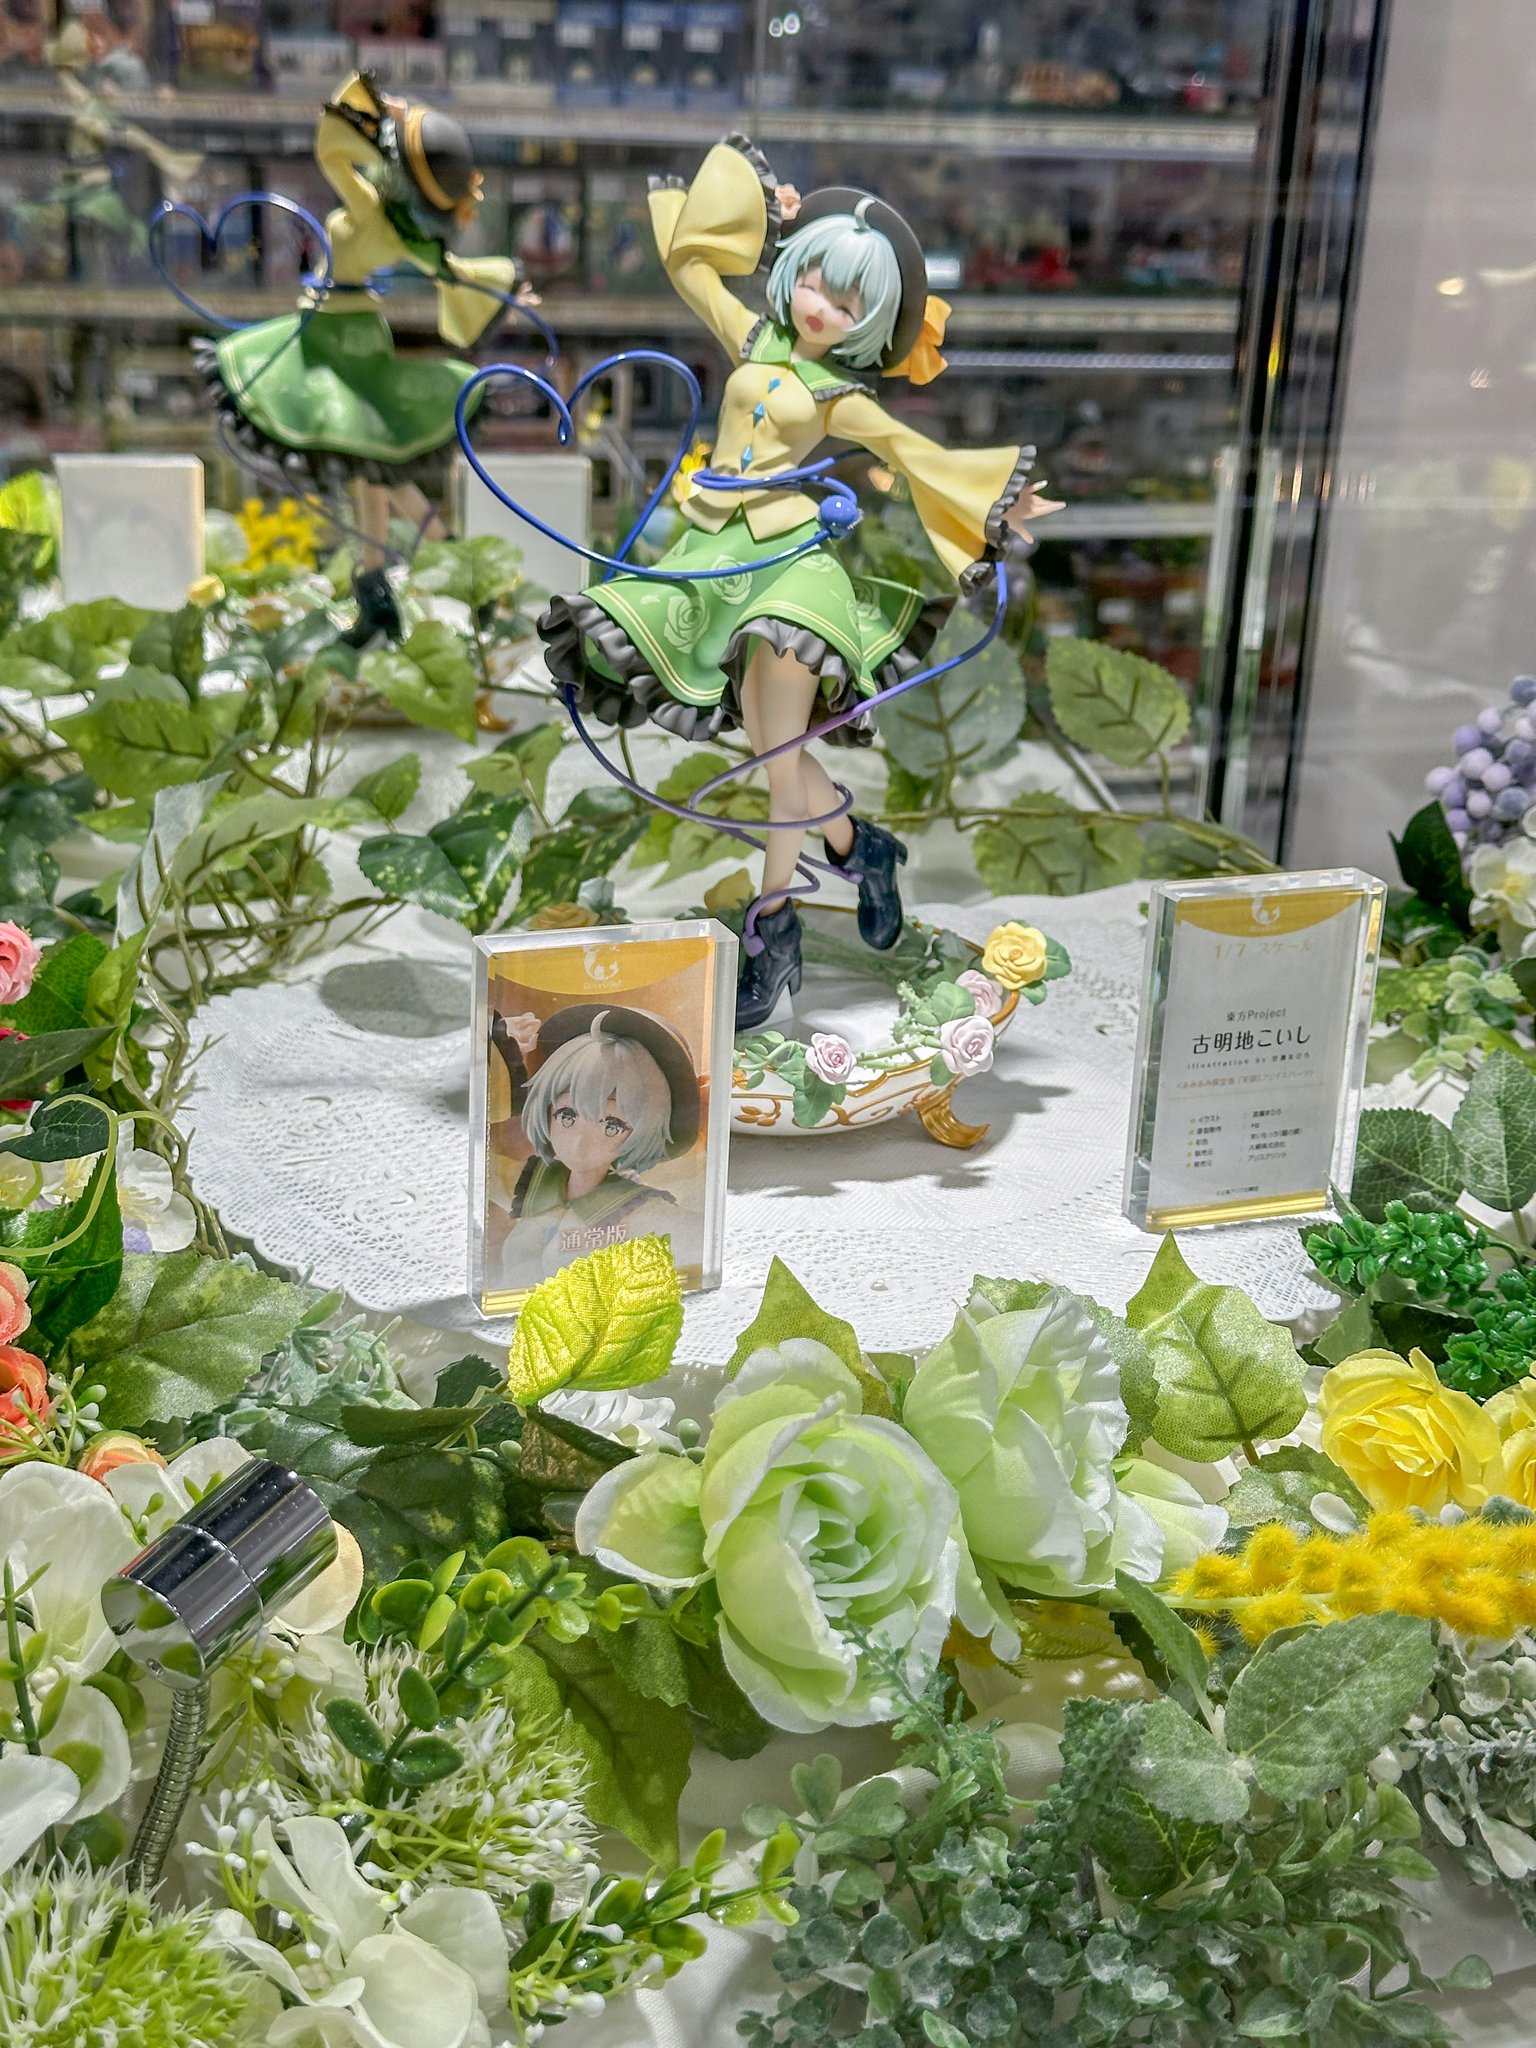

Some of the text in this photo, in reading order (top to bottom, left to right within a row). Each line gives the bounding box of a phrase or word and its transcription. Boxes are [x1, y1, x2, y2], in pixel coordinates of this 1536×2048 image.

[1215, 943, 1246, 959] 1/7
[1226, 1008, 1287, 1022] 東方Project
[1192, 1025, 1311, 1054] 古明地こいし
[561, 1224, 628, 1252] 通常版
